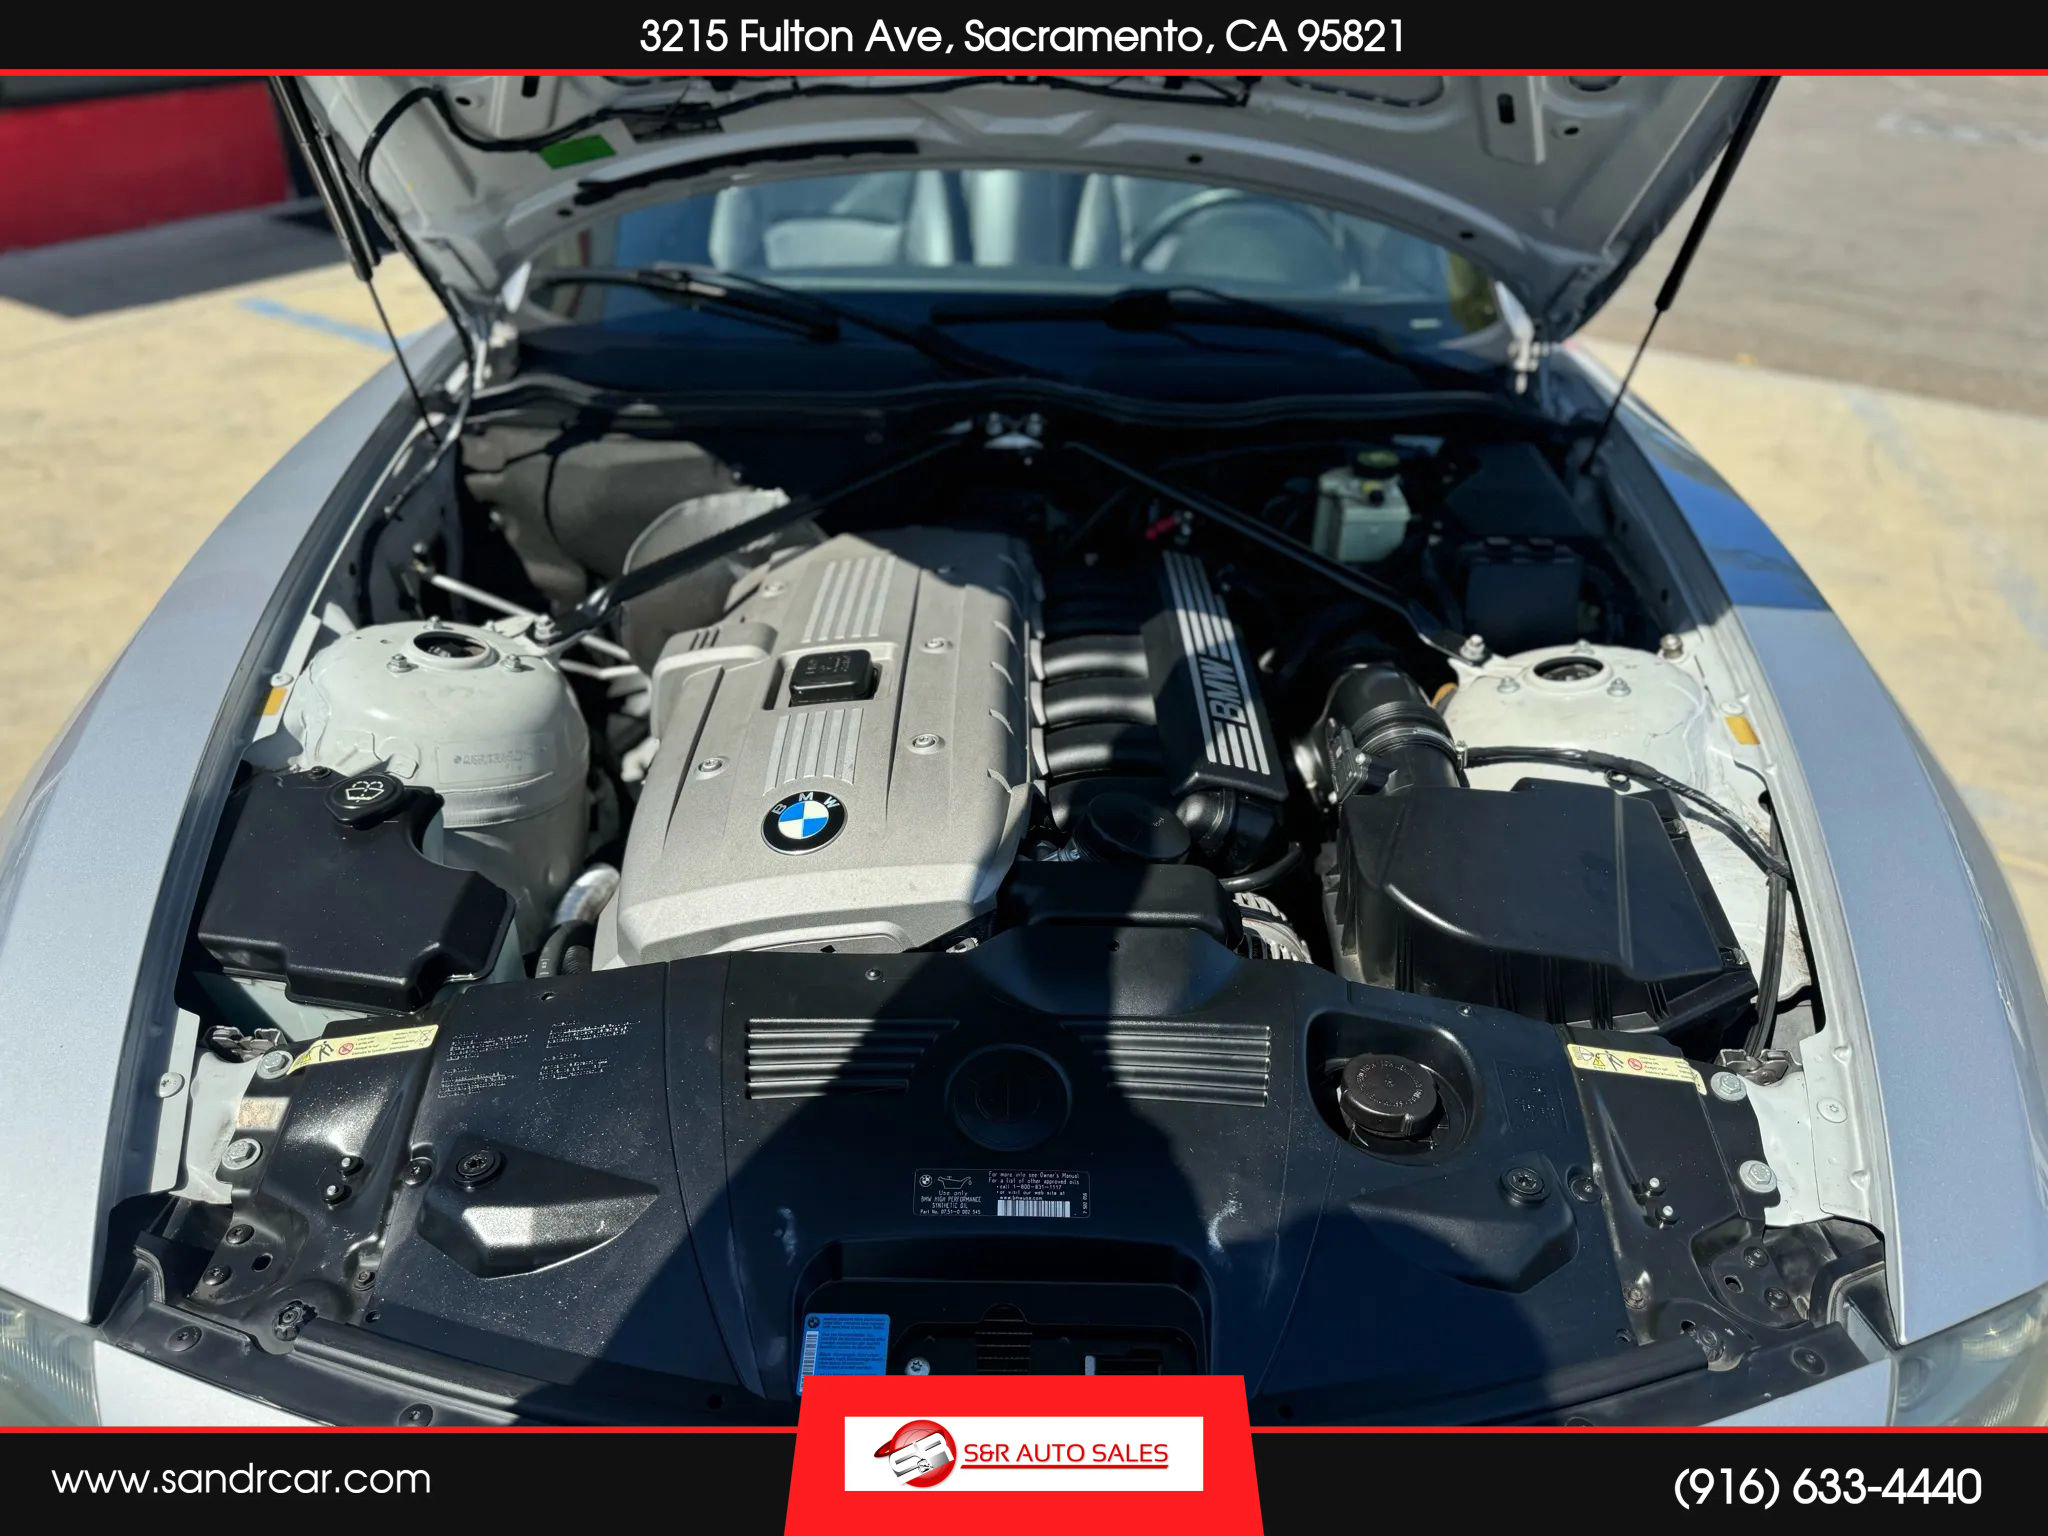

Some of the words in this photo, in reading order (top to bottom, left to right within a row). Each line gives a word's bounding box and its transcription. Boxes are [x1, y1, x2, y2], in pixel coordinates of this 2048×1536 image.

[1199, 656, 1247, 724] BMW
[772, 791, 841, 815] BMW
[1039, 1171, 1060, 1179] Owner's
[920, 1195, 932, 1203] BMW
